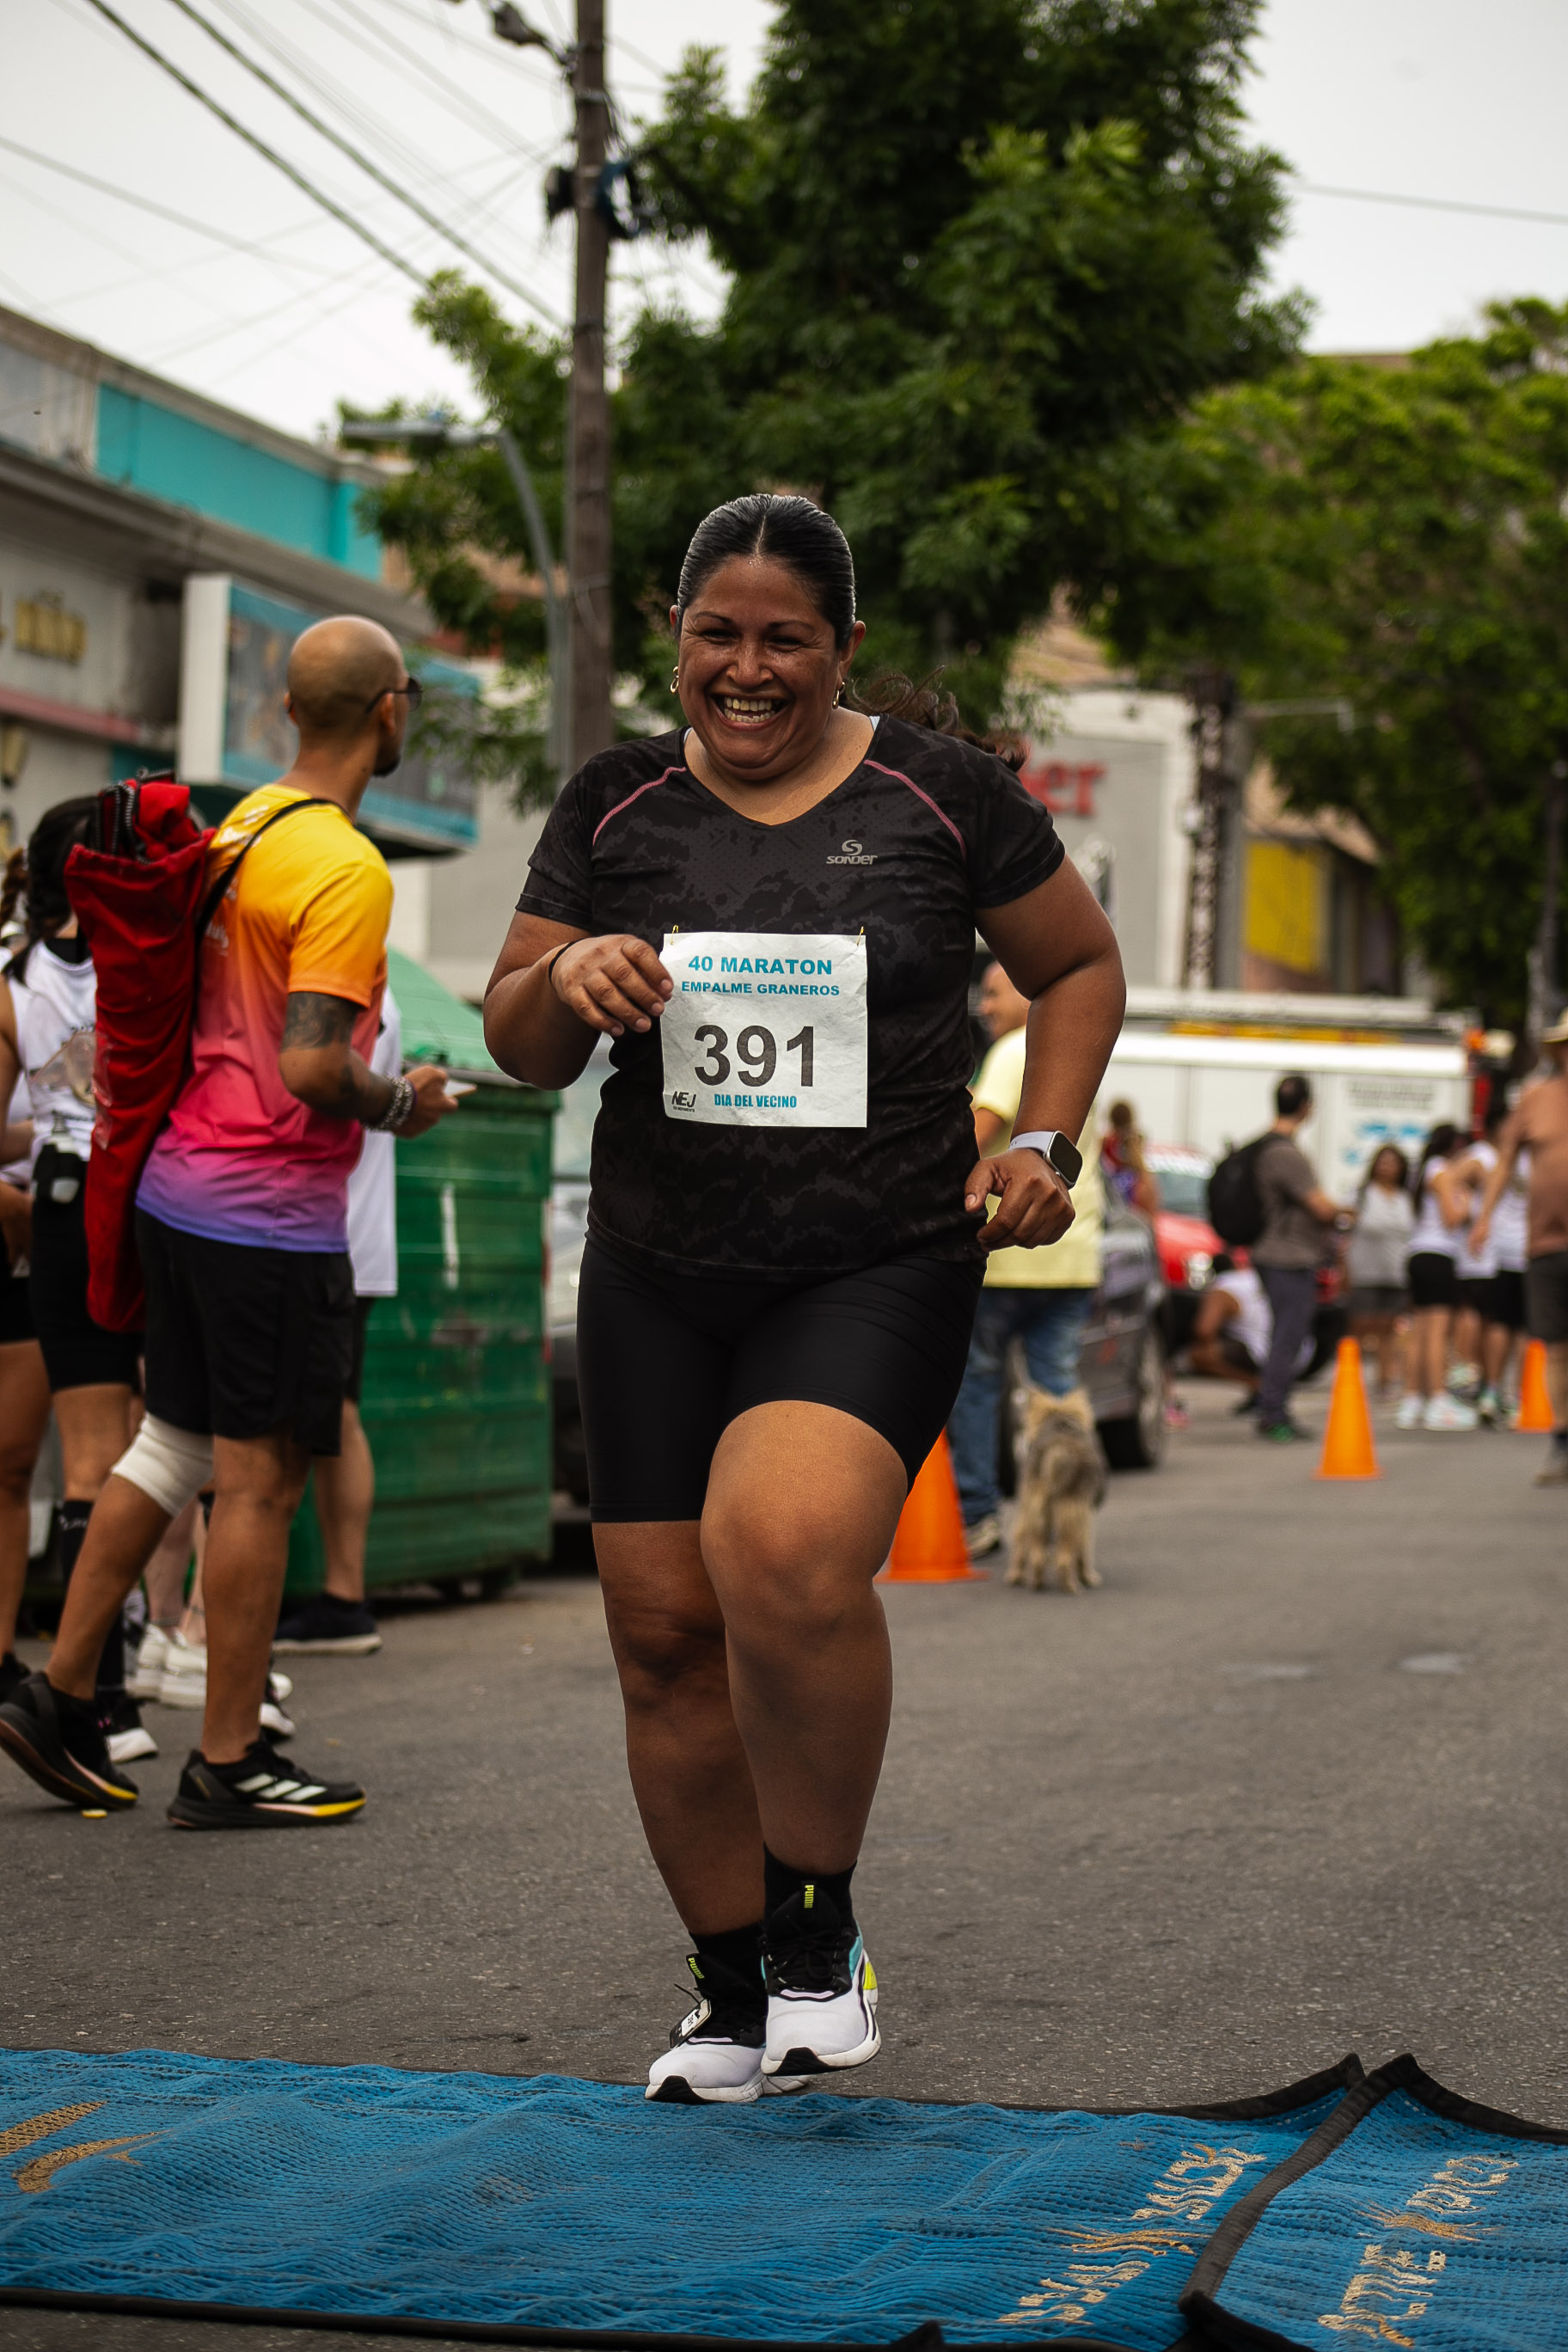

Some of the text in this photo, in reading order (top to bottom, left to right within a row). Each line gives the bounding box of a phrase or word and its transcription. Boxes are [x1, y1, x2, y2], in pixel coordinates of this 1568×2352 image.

[689, 956, 832, 975] 40 MARATON
[682, 981, 840, 995] EMPALME GRANEROS
[694, 1024, 814, 1087] 391
[671, 1091, 696, 1107] NEJ
[714, 1093, 797, 1108] DIA DEL VECINO
